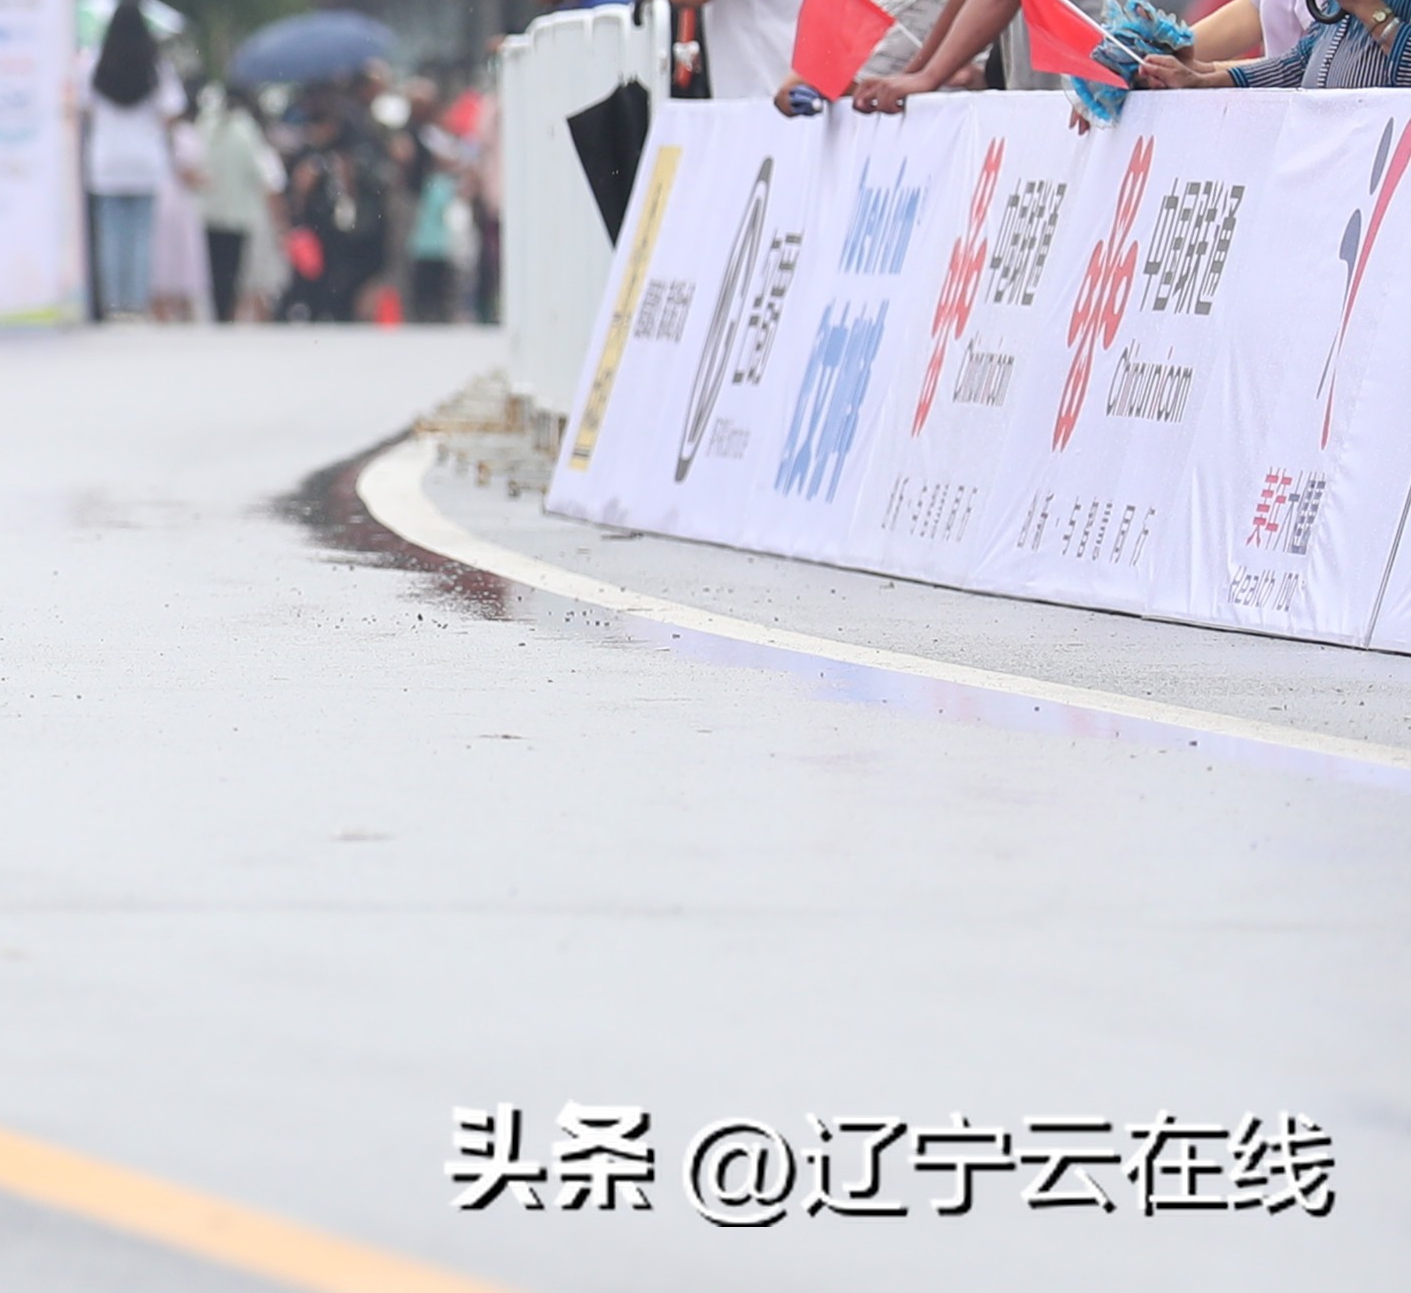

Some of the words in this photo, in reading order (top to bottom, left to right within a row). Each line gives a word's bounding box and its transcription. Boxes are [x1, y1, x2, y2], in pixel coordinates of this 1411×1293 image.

[984, 178, 1068, 307] 中国联通
[1140, 177, 1245, 316] 中国联通
[1245, 466, 1326, 555] 美年大健康
